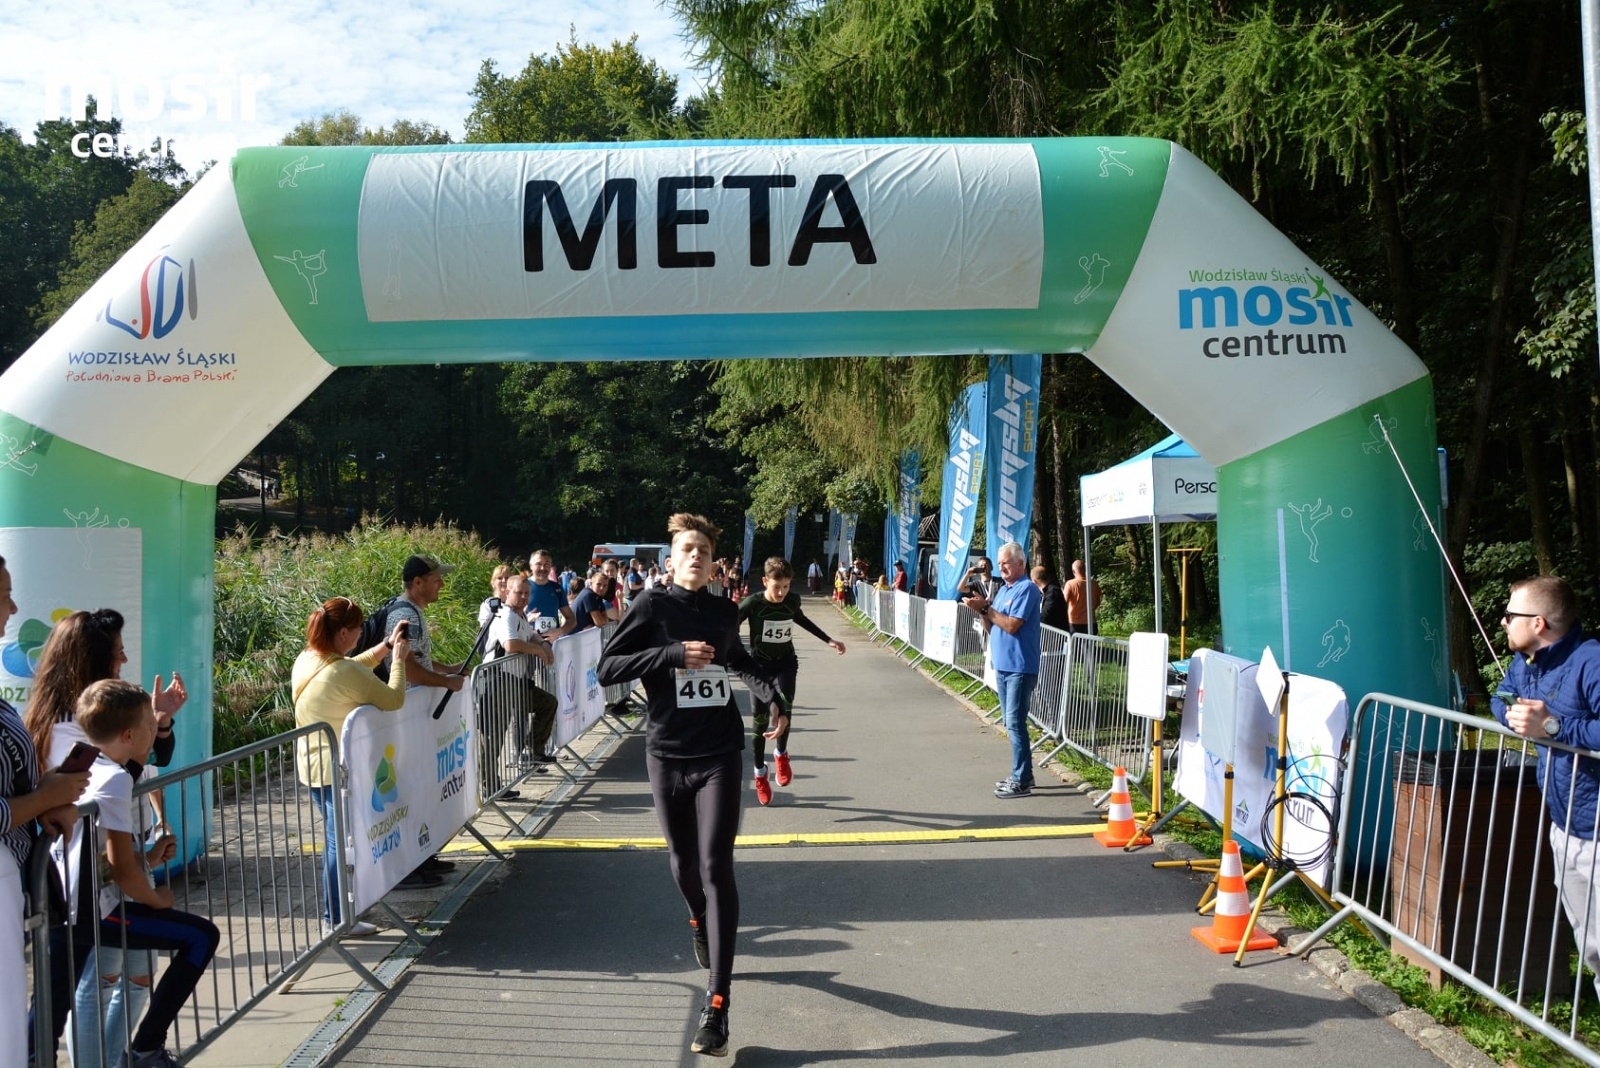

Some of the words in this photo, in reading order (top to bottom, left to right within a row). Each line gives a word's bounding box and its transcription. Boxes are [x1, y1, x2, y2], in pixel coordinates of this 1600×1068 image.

[523, 174, 877, 272] META
[1189, 269, 1268, 283] Wodzisław
[1271, 267, 1308, 285] Śląski
[1178, 285, 1353, 330] mosir
[1202, 329, 1347, 359] centrum
[68, 351, 171, 366] WODZISŁAW
[176, 347, 236, 369] ŚLĄSKI
[146, 369, 191, 383] Brama
[1022, 399, 1036, 454] SPORT
[970, 450, 982, 495] SPORT
[541, 620, 552, 629] 84
[764, 627, 792, 639] 454
[679, 679, 726, 699] 461
[1, 728, 24, 773] LAURA
